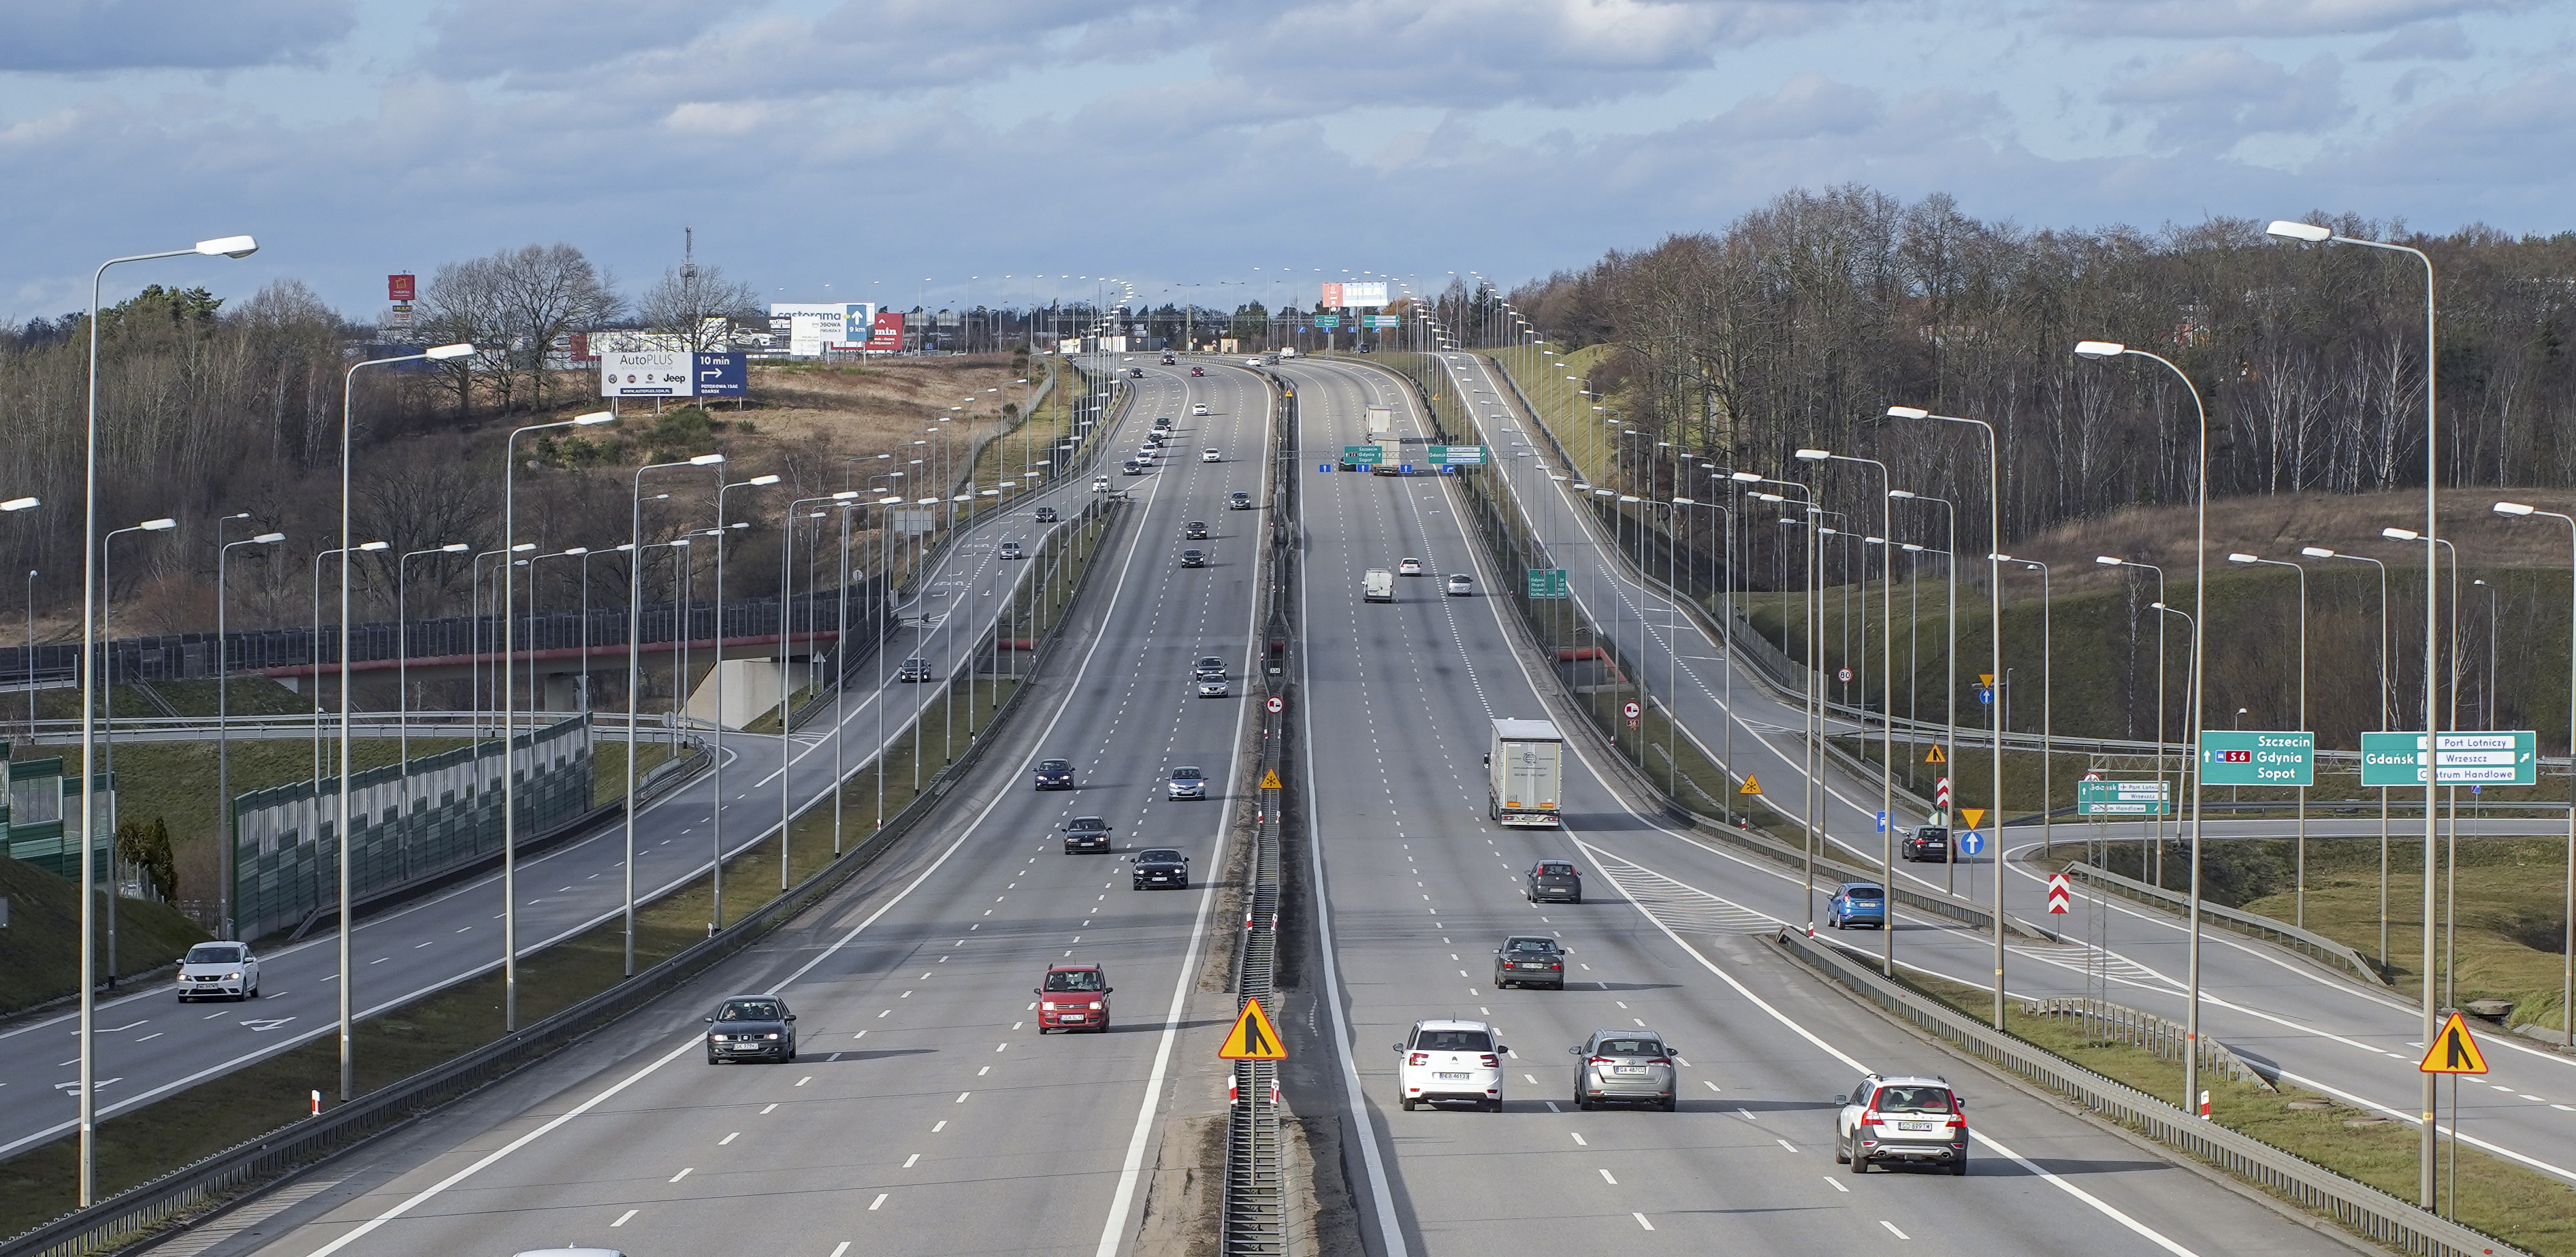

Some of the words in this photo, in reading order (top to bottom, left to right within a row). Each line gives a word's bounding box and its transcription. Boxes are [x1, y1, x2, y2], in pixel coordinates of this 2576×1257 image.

[620, 354, 673, 365] AutoPLUS
[700, 356, 711, 365] 10
[713, 356, 730, 365] min
[664, 374, 685, 384] Jeep
[2258, 736, 2311, 747] Szczecin
[2445, 739, 2464, 747] Port
[2468, 739, 2507, 749] Lotniczy
[2257, 751, 2302, 766] Gdynia
[2366, 753, 2414, 765] Gdańsk
[2446, 755, 2487, 763] Wrzeszcz
[2257, 767, 2296, 781] Sopot
[2420, 770, 2460, 779] Ctrum
[2464, 770, 2512, 779] Handlowe
